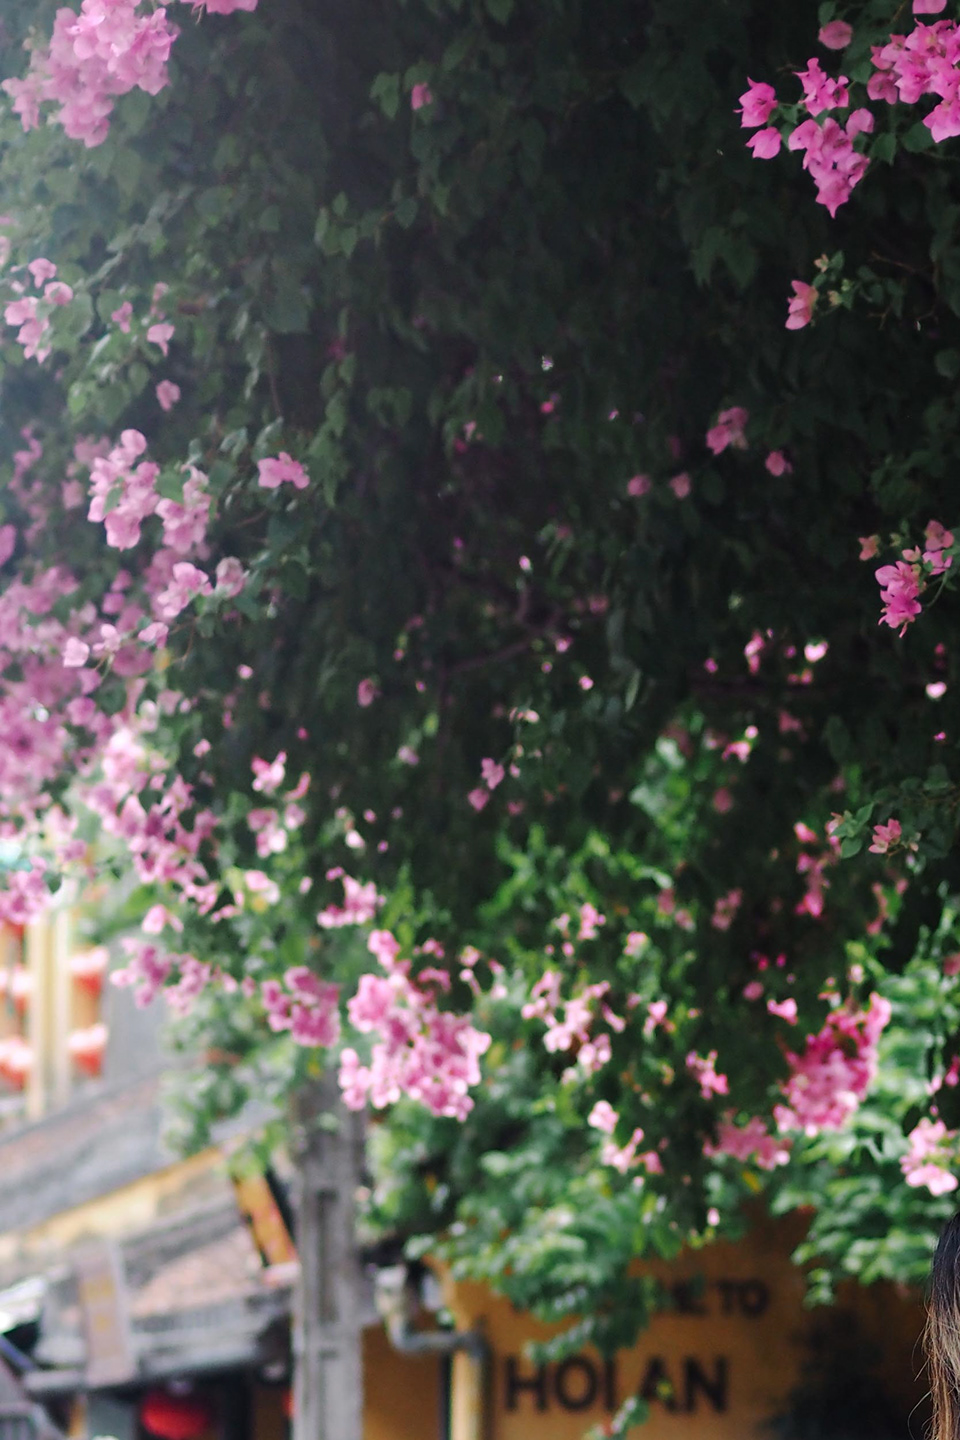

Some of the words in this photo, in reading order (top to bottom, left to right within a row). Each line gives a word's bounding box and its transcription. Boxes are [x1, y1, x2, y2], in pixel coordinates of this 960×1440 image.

[718, 1278, 769, 1318] TO
[504, 1354, 617, 1413] HOI
[639, 1354, 730, 1413] AN
